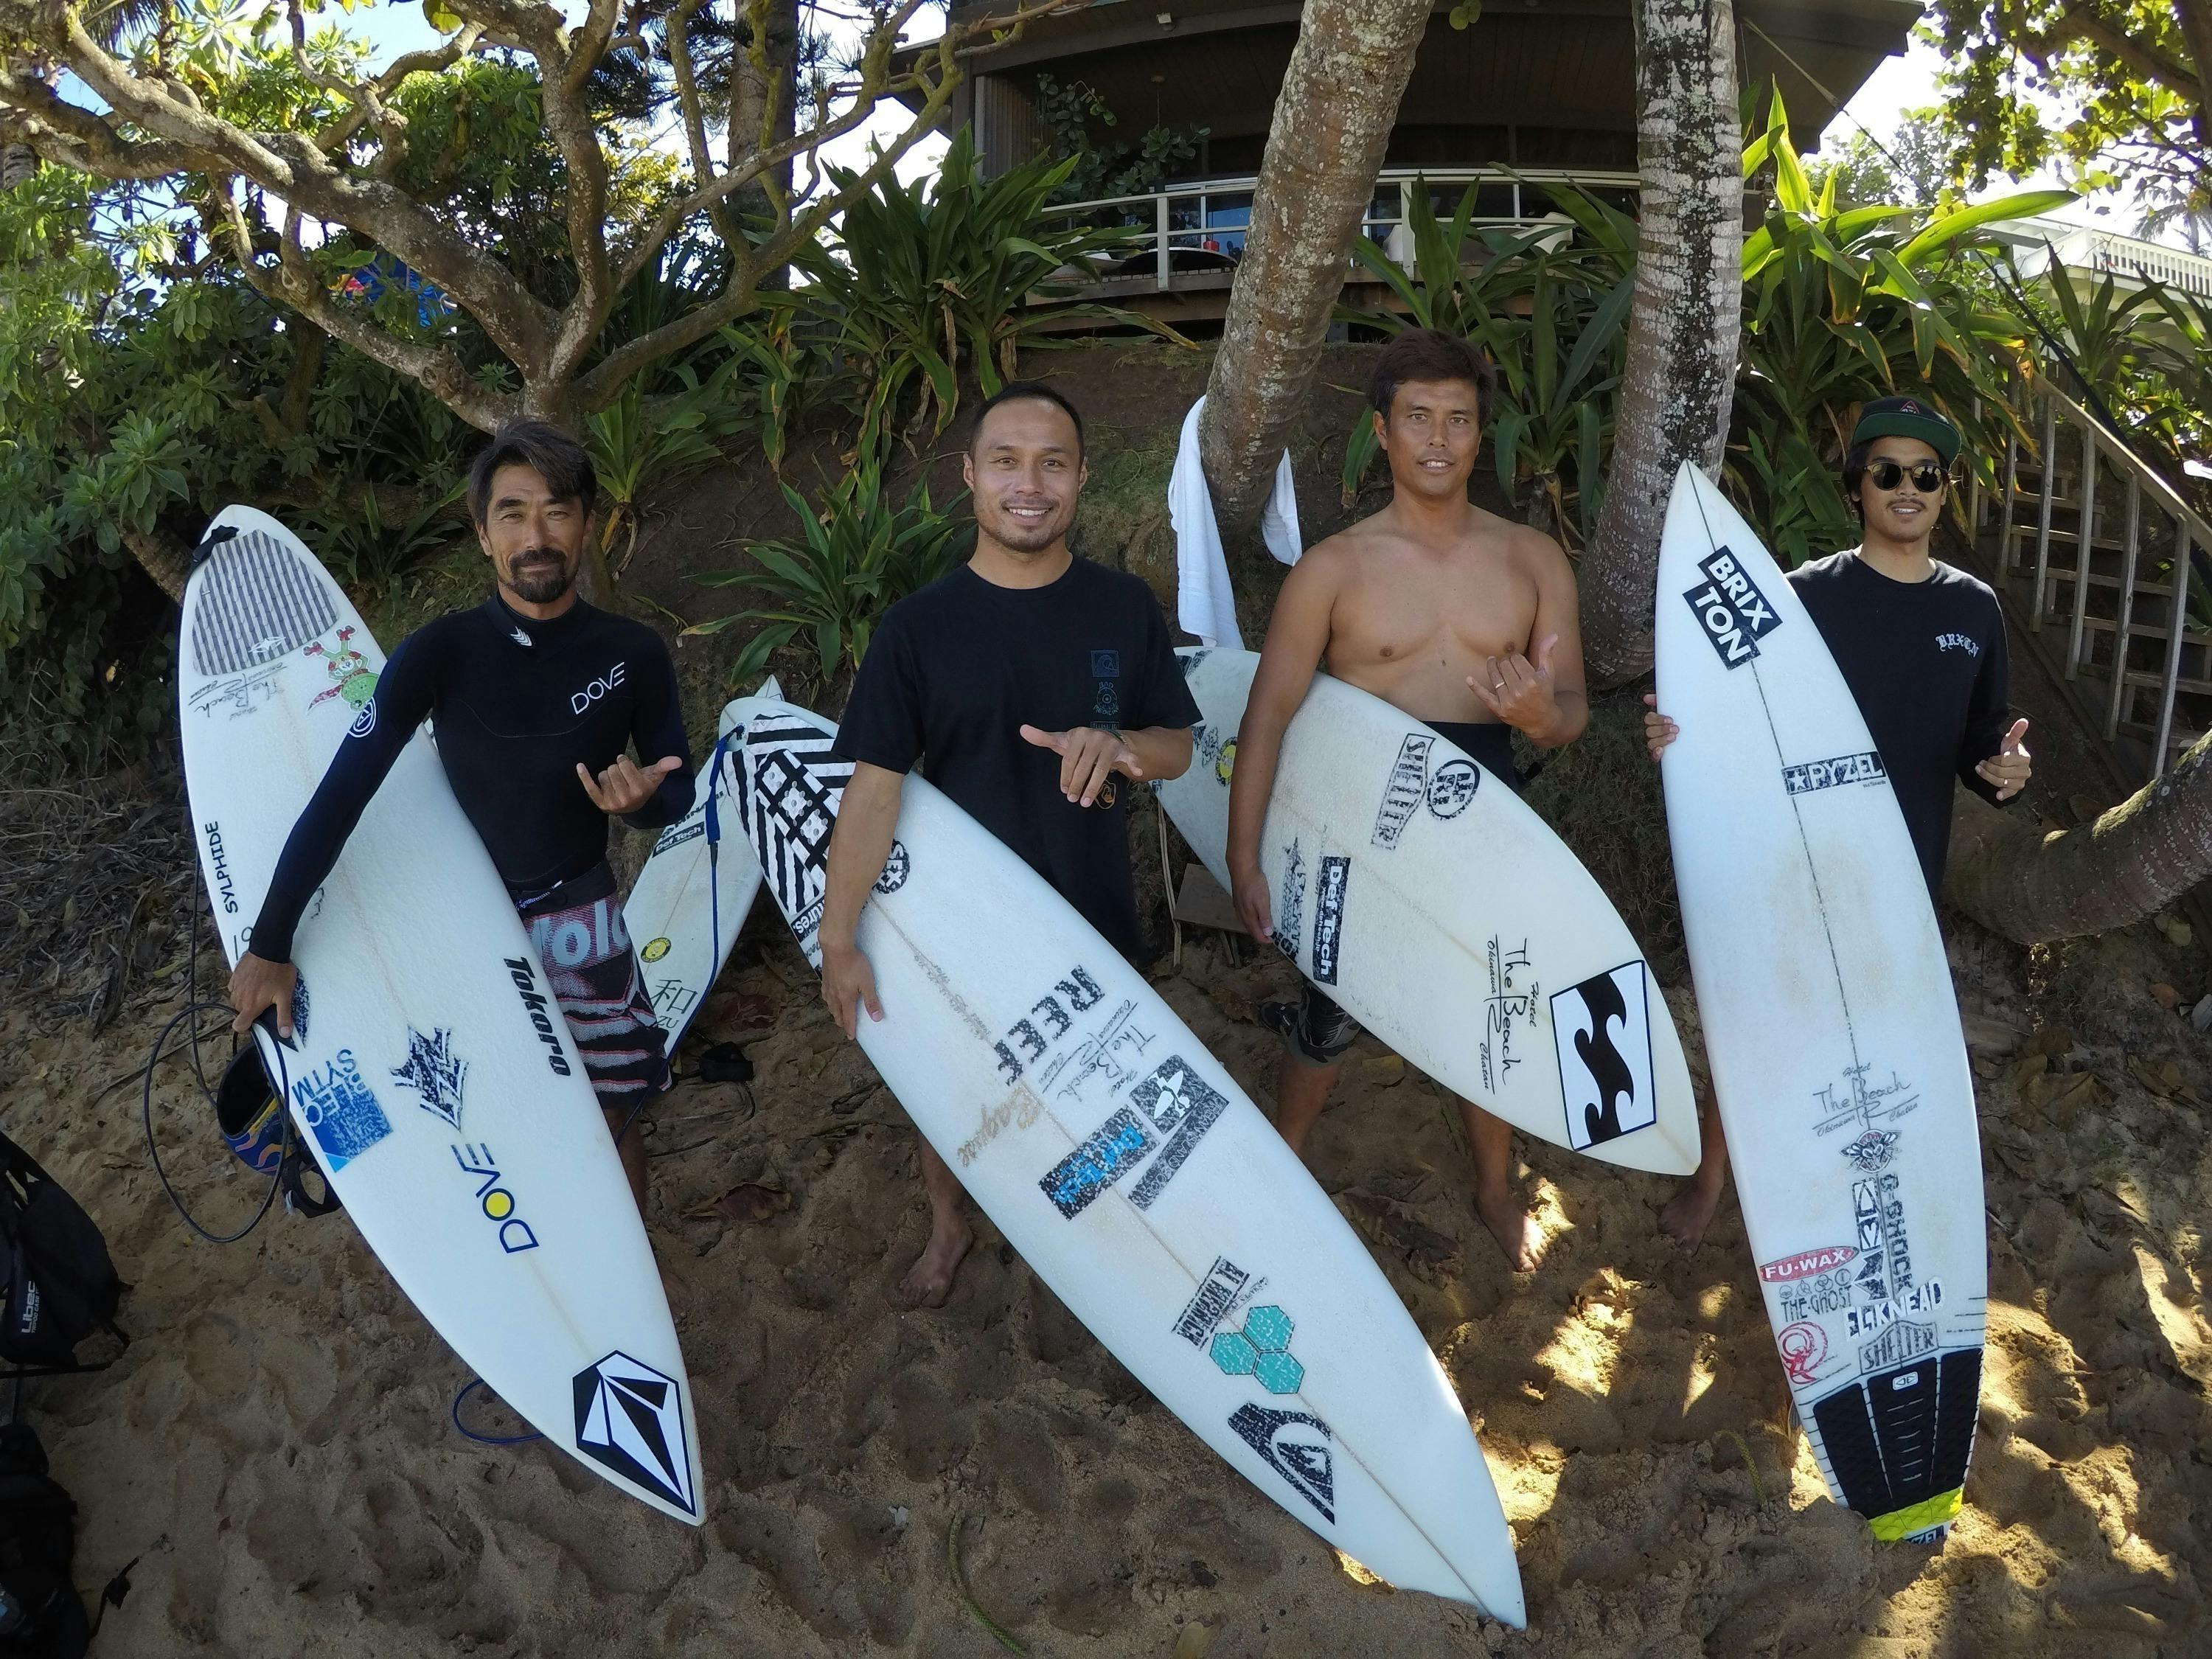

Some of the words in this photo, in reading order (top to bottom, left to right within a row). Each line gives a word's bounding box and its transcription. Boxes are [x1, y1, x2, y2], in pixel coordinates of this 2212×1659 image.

[1708, 554, 1774, 631] BRIX
[1694, 586, 1752, 662] TON
[571, 661, 625, 715] DOVE
[1807, 754, 1883, 789] PYZEL
[655, 838, 674, 853] Def
[675, 826, 701, 841] Tech
[204, 821, 239, 914] SYLPHIDE
[1325, 865, 1343, 912] Def
[793, 899, 825, 934] tures.
[1320, 914, 1337, 975] Tech
[1486, 939, 1498, 995] Okinawa
[1504, 937, 1531, 990] The
[503, 956, 571, 1077] Tokoro
[650, 979, 698, 1015] 和
[1528, 981, 1540, 1028] Hotel
[993, 964, 1106, 1087] REEF
[1110, 1024, 1157, 1057] The
[1494, 995, 1528, 1086] Beach
[291, 1048, 357, 1107] SYTM
[1056, 1043, 1124, 1103] Beach
[1479, 1042, 1489, 1091] Chatan
[1812, 1082, 1850, 1114] The
[1851, 1071, 1912, 1115] Beach
[450, 1142, 540, 1254] DOVE
[21, 1280, 35, 1333] Libec
[1863, 1325, 1935, 1370] SHELTER
